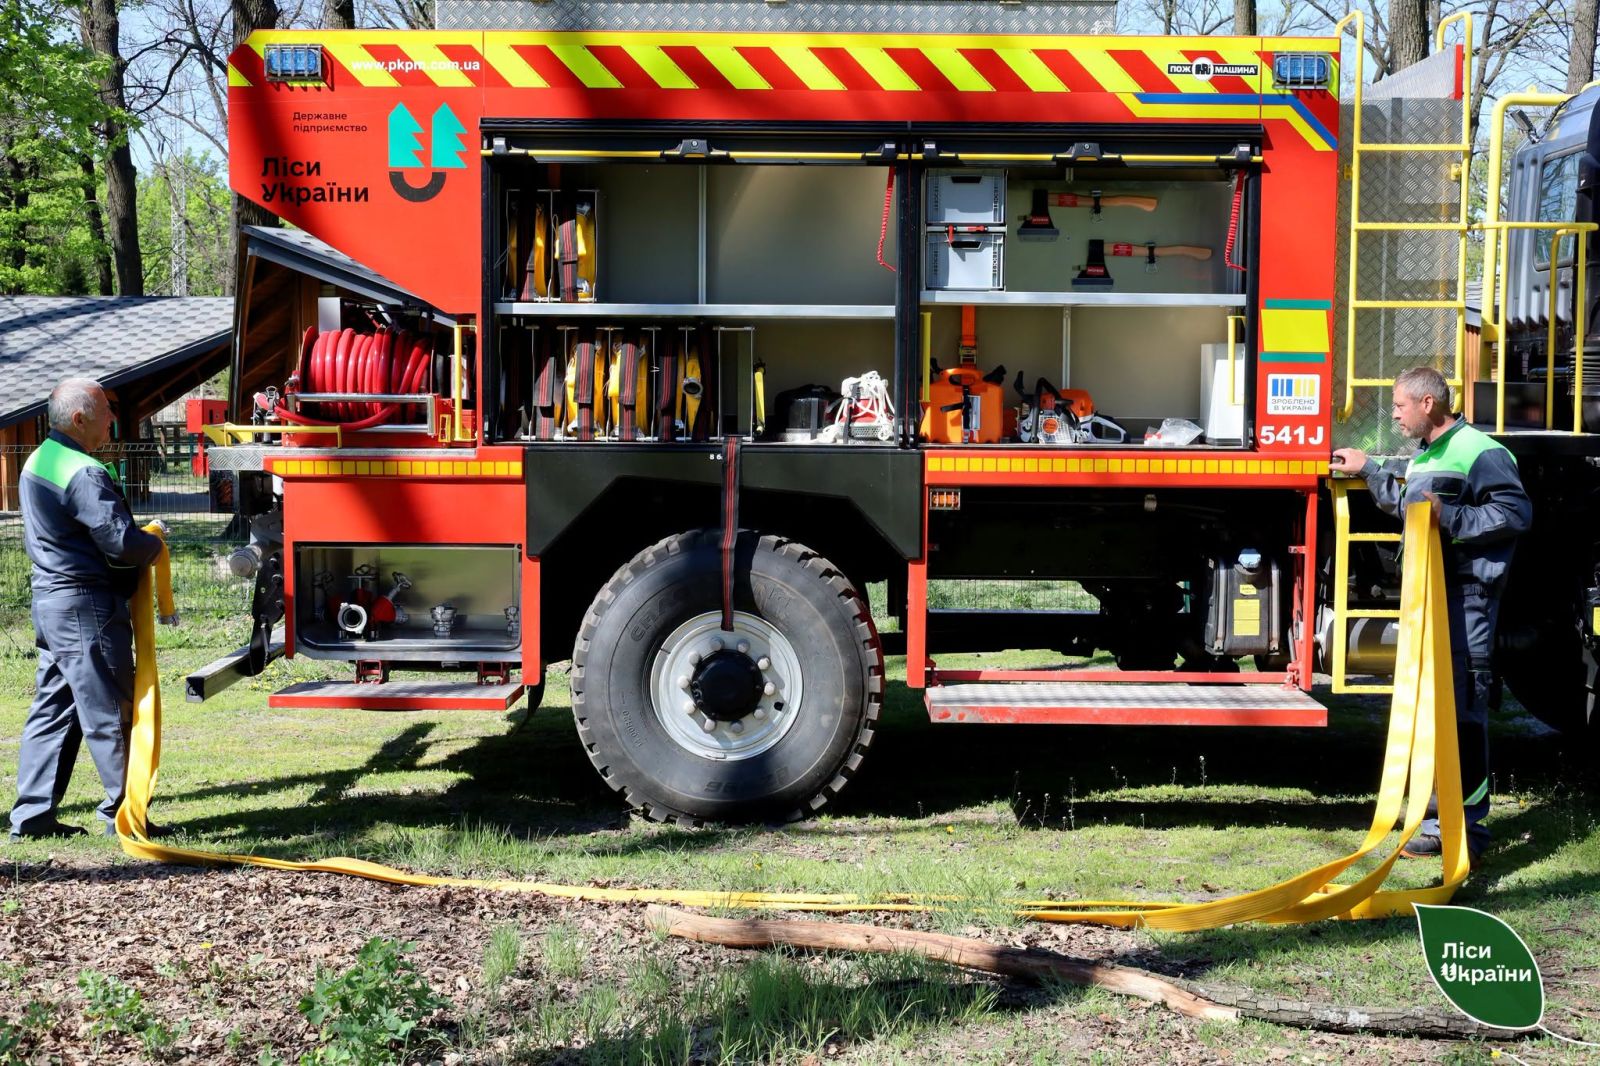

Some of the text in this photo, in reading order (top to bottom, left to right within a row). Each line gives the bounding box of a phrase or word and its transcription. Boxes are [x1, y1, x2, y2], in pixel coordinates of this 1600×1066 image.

[351, 59, 480, 72] www.pkpm.com.ua
[1169, 65, 1191, 73] ПОЖ
[1214, 66, 1256, 74] МАШИНА
[292, 112, 348, 121] Державне
[293, 123, 368, 133] підприємство
[261, 156, 321, 177] Ліси
[261, 182, 369, 207] України
[1260, 425, 1324, 445] 541J
